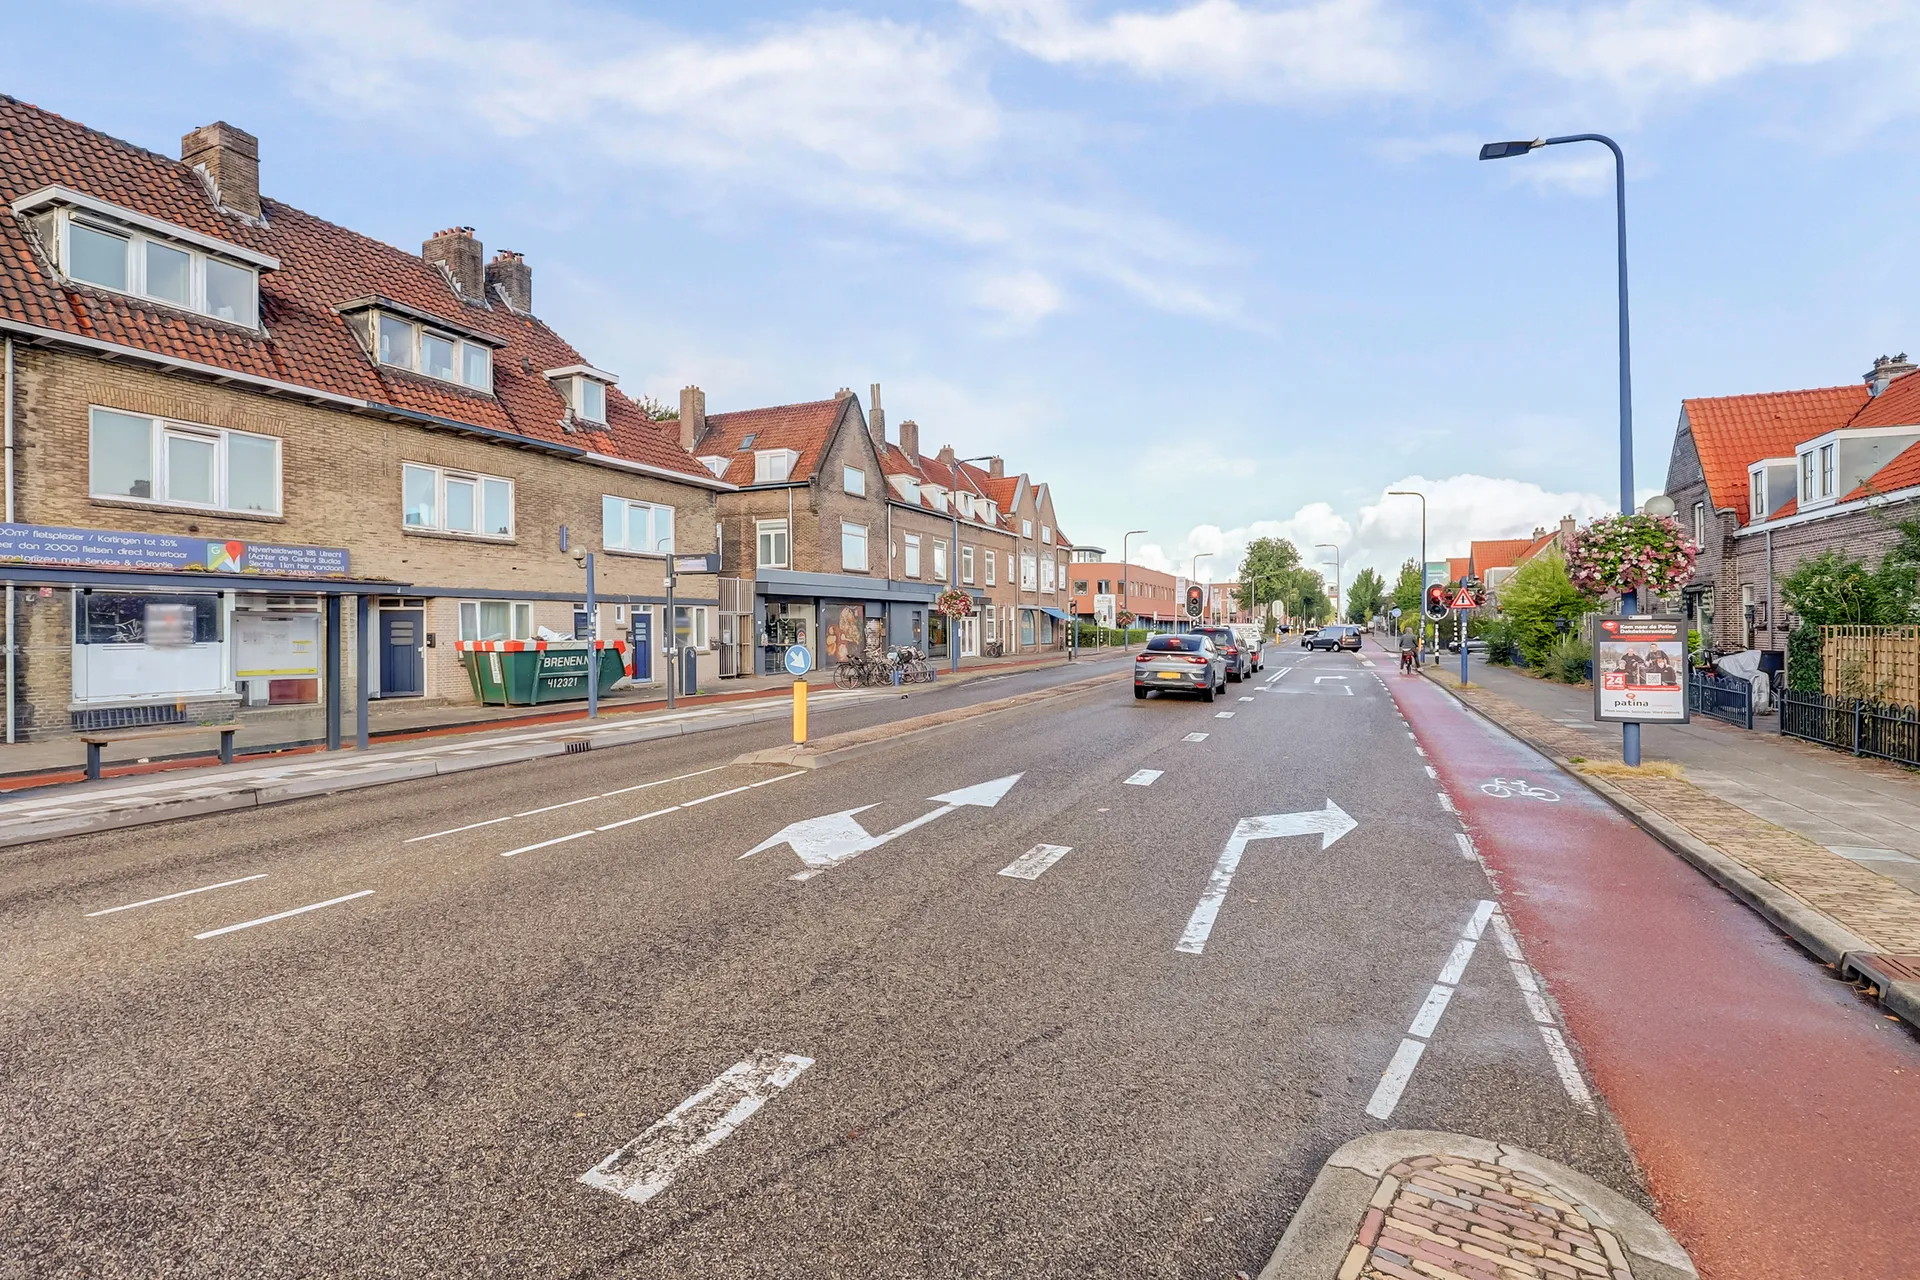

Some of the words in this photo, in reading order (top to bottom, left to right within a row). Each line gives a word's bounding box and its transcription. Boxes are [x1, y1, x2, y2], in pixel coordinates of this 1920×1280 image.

[33, 530, 84, 541] fietsplezier
[98, 535, 140, 545] Kortingen
[44, 543, 78, 552] 2000
[82, 546, 113, 554] fietsen
[118, 548, 143, 556] direct
[146, 549, 187, 558] leverbaar
[248, 546, 302, 556] Nijverheidsweg
[85, 557, 120, 566] Service
[136, 560, 174, 568] Garantie
[544, 656, 589, 667] BRENEN.N
[548, 677, 577, 688] 412321
[1606, 676, 1623, 685] 24
